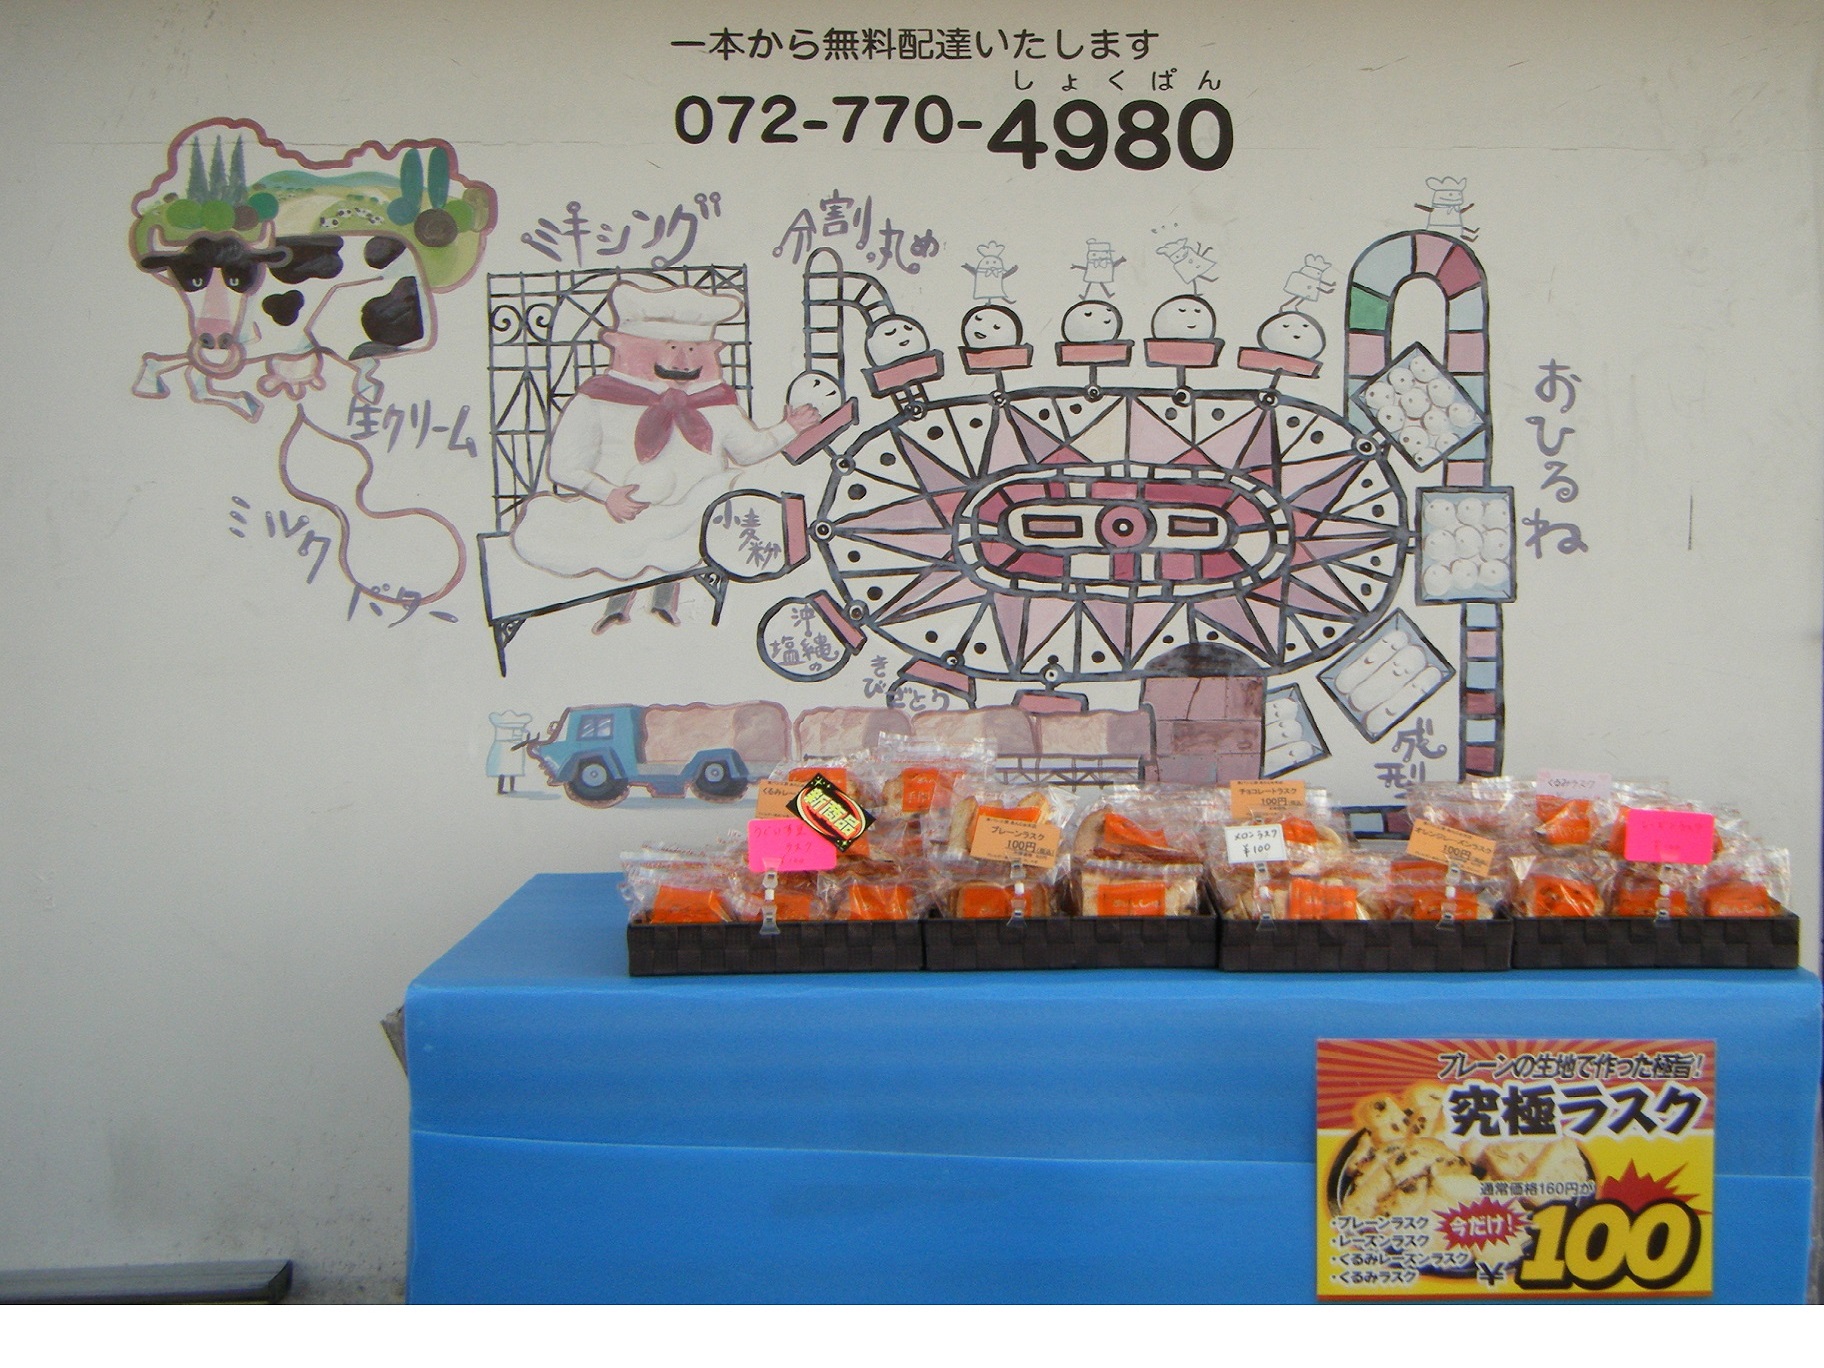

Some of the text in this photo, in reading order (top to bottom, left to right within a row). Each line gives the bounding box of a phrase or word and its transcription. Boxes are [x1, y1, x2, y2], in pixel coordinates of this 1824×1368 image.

[670, 27, 1159, 61] 一本から無料配達いたします
[1013, 67, 1221, 92] しょくぱん
[674, 94, 1234, 171] 072-770-4980
[520, 192, 721, 269] ミキシング
[347, 396, 478, 458] 生クリーム
[1522, 358, 1589, 559] おひるね
[229, 495, 331, 585] ミルク
[712, 500, 781, 570] 小麦粉
[803, 786, 861, 837] 新商品
[1447, 1083, 1704, 1138] 究極ラスク
